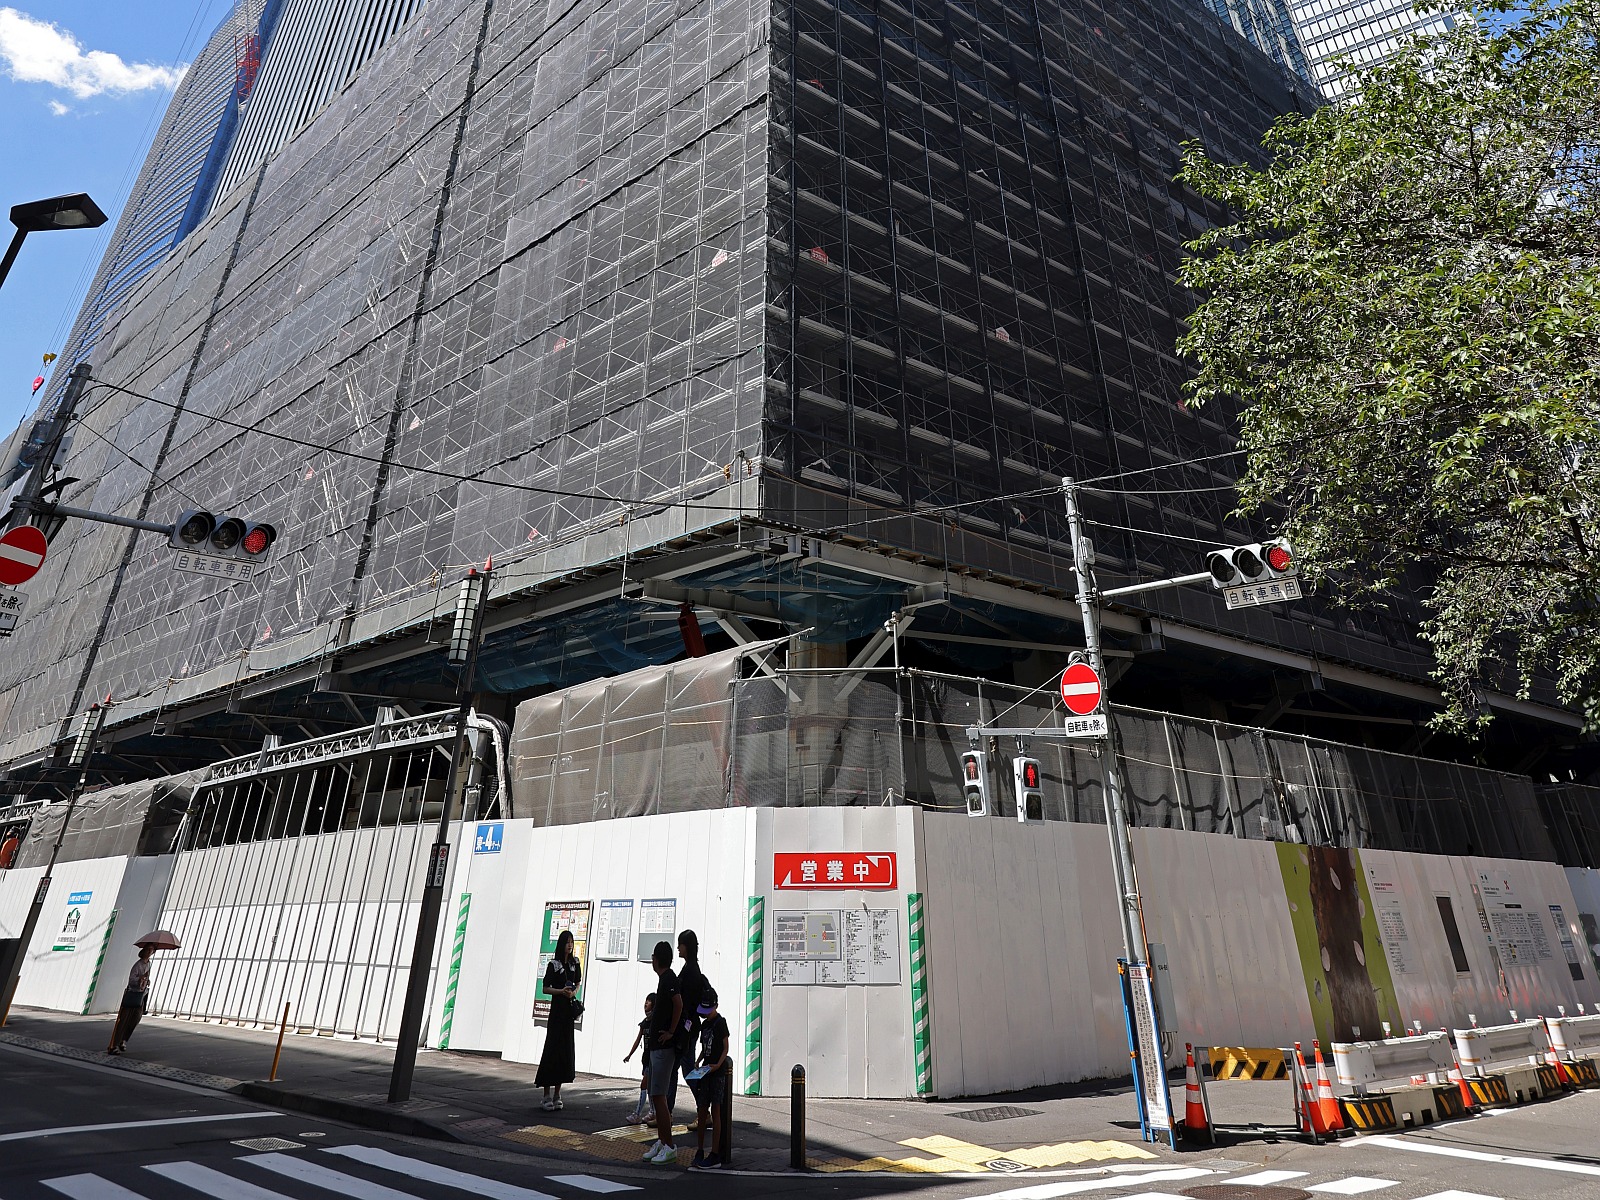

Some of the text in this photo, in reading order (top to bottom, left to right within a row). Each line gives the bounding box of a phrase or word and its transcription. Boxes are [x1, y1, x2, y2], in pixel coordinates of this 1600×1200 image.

[178, 554, 252, 579] 自転車専用
[0, 593, 24, 612] を除く
[1229, 581, 1297, 604] 自転車専用
[1067, 719, 1106, 733] 自転車を除く
[800, 859, 870, 882] 営業中
